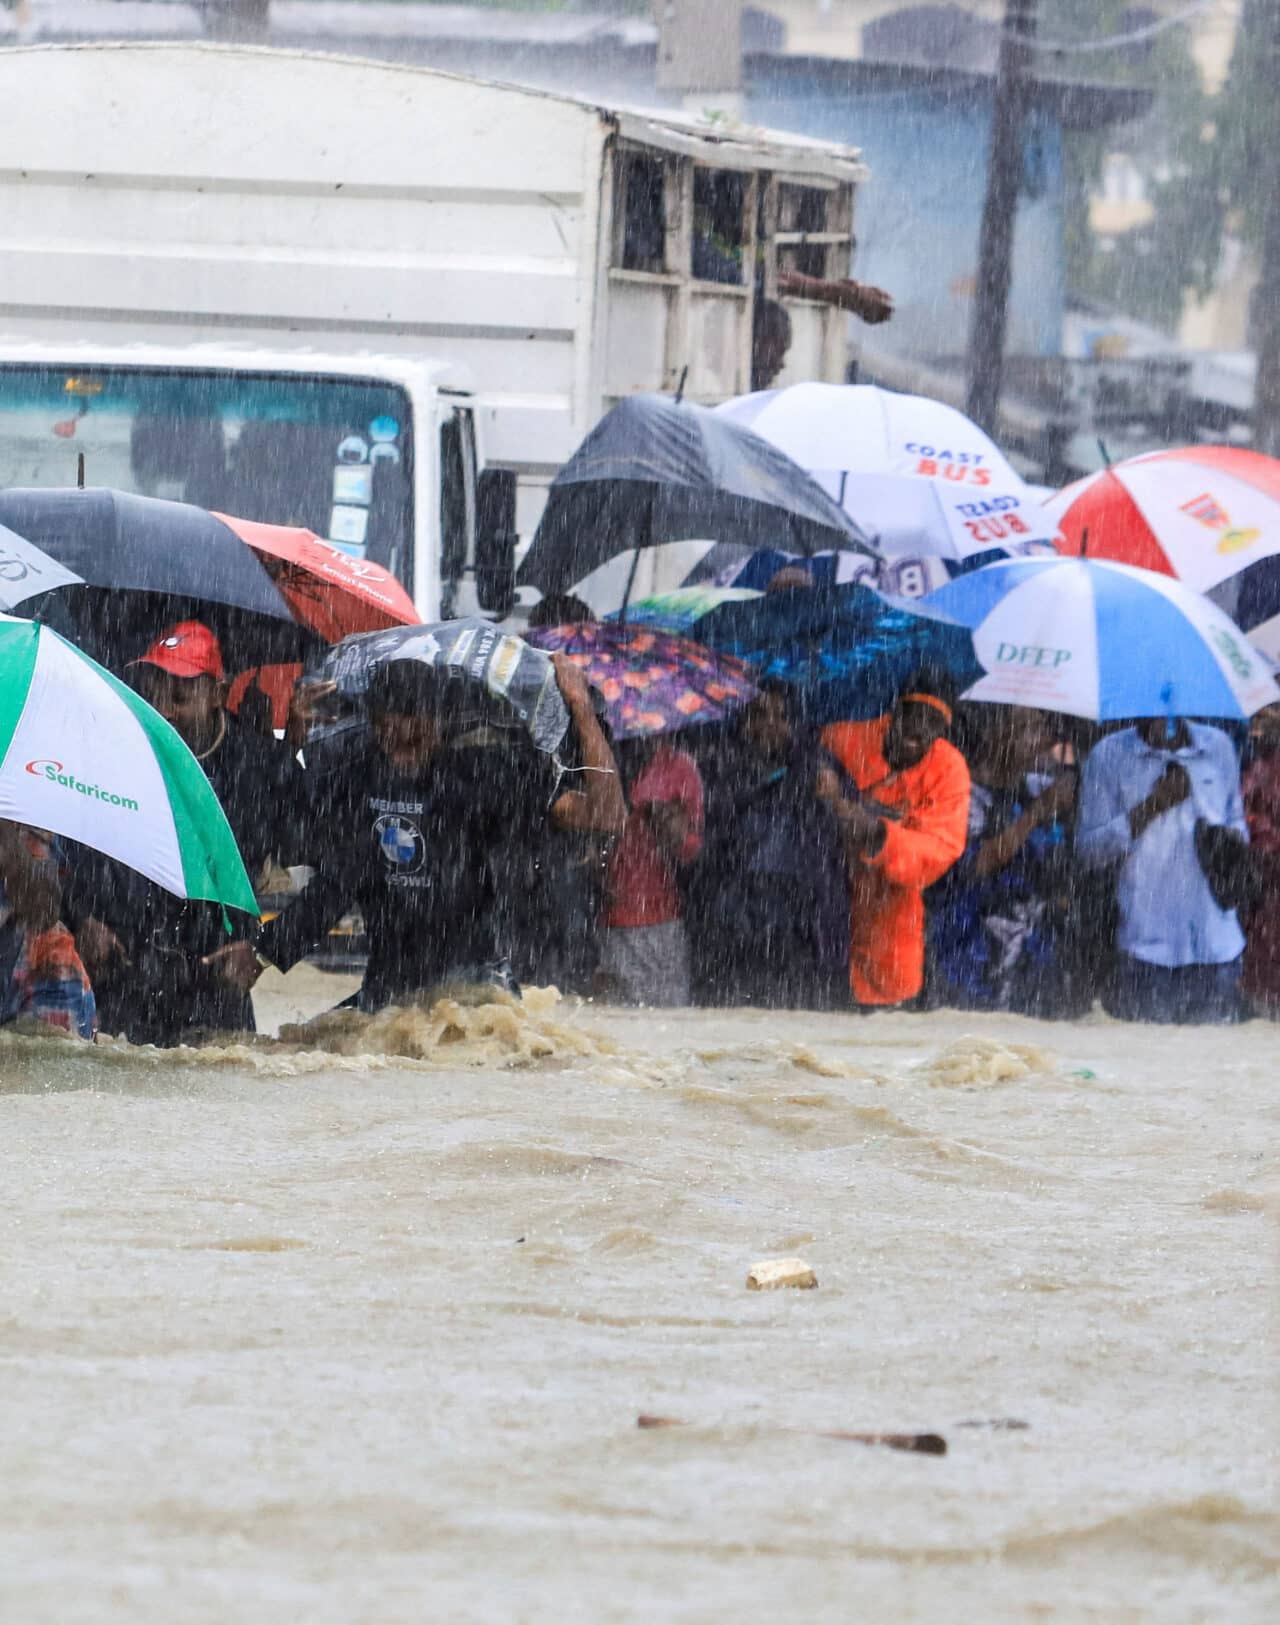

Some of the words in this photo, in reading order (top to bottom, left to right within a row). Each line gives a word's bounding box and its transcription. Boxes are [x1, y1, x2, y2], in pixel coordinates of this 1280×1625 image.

[905, 442, 983, 464] COAST
[918, 458, 991, 485] BUS
[44, 765, 139, 811] Safaricom
[370, 797, 423, 815] MEMBER
